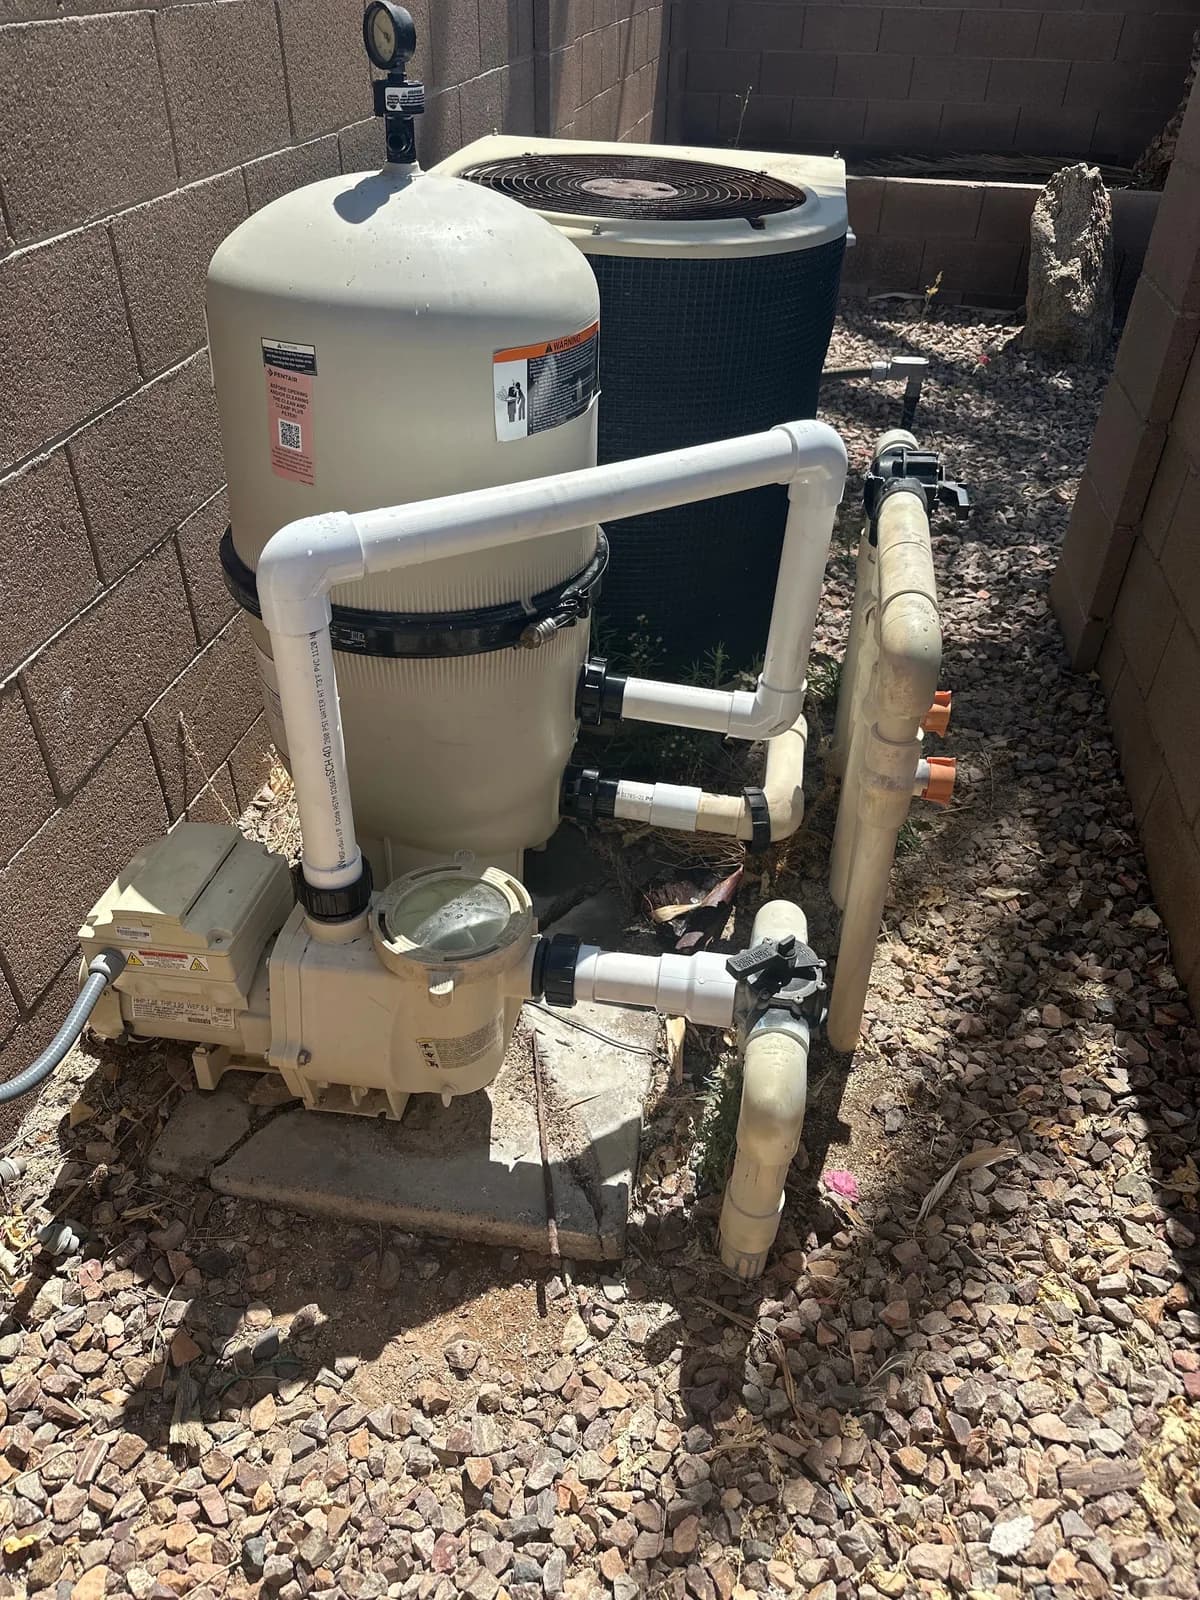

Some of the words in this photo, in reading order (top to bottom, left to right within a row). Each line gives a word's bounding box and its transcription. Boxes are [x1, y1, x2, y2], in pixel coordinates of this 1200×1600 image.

[553, 334, 581, 351] WARNING
[274, 371, 298, 383] PENTAIR
[281, 398, 296, 407] CLEAN
[310, 641, 319, 657] 1120
[313, 658, 321, 673] PVC
[317, 689, 325, 698] AT
[318, 699, 327, 720] WATER
[321, 720, 329, 732] PSI
[322, 746, 332, 758] 40
[324, 758, 335, 777] SCH
